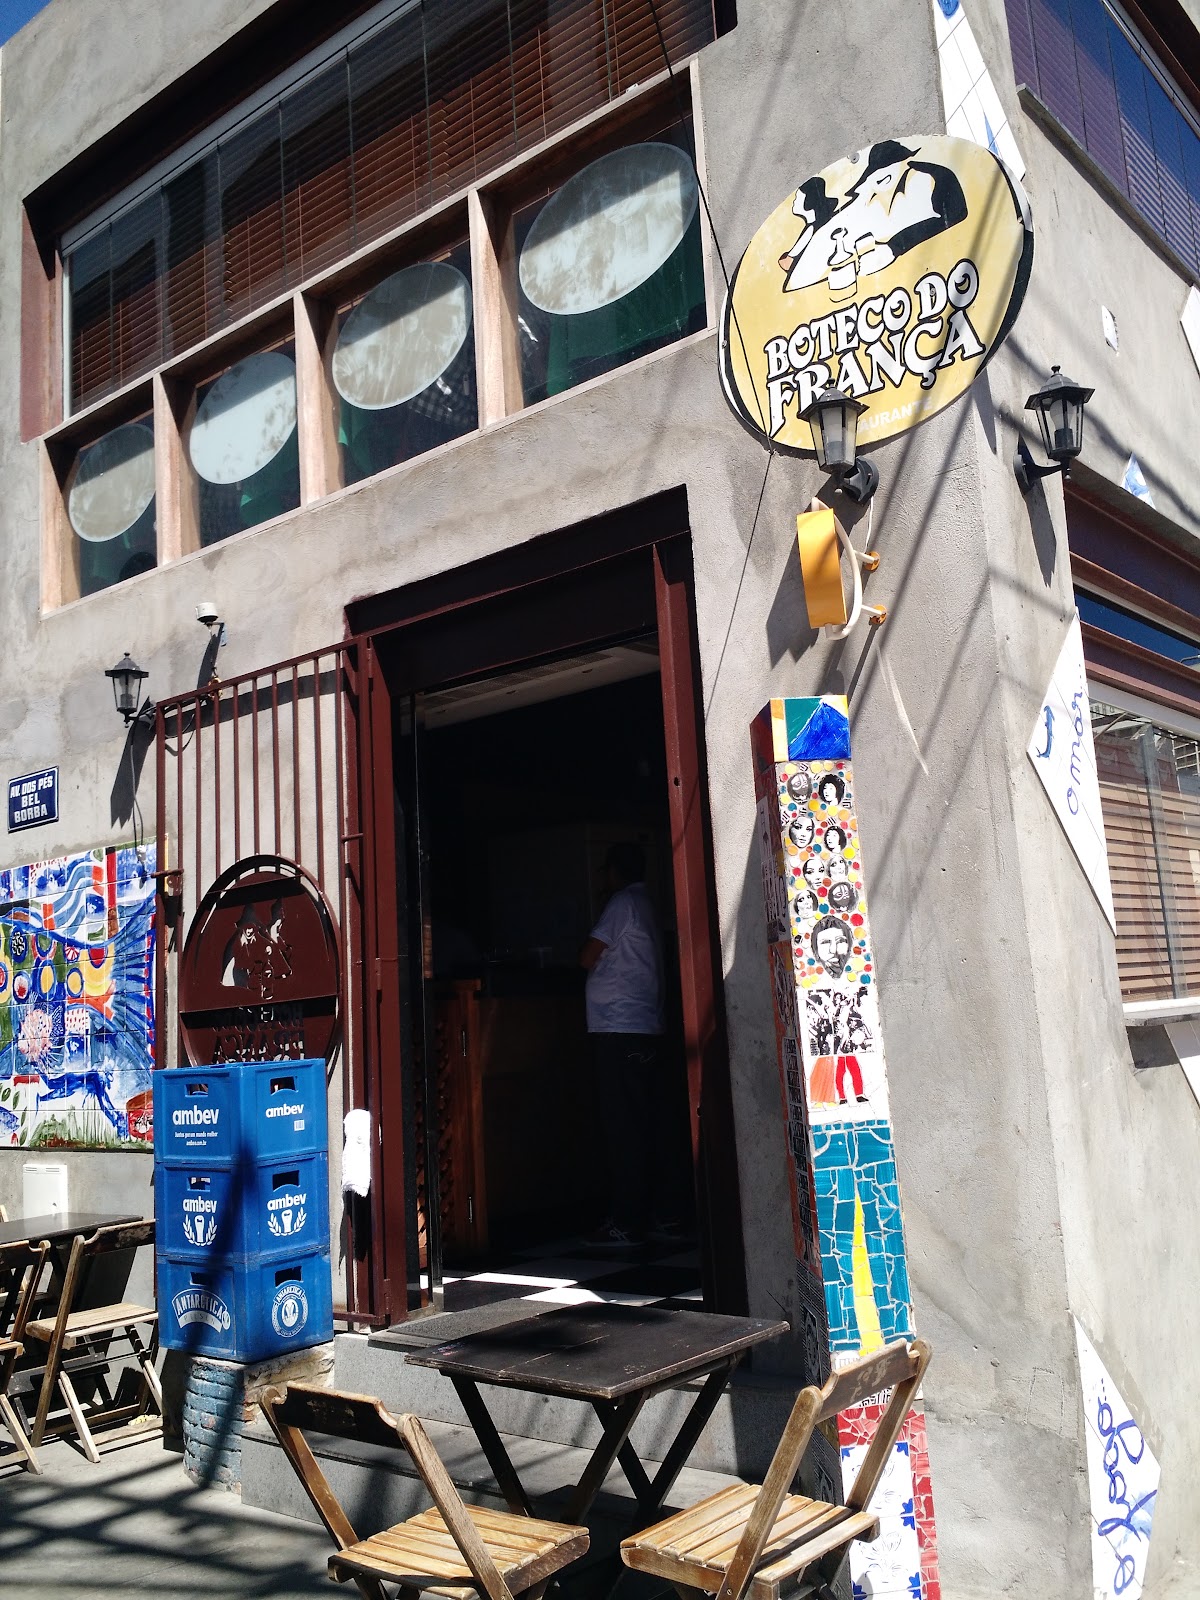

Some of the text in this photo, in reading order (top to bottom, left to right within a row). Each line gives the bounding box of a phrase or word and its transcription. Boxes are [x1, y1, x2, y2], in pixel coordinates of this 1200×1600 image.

[764, 258, 980, 380] BOTECO DO
[767, 308, 987, 439] FRANÇA
[858, 397, 935, 432] AURANTE
[10, 772, 53, 798] AV. DOS PÉS
[21, 792, 40, 808] BEL
[14, 803, 48, 823] BORBA
[172, 1104, 219, 1126] ambev
[265, 1103, 305, 1118] ambev
[182, 1195, 217, 1214] ambev
[267, 1193, 307, 1211] ambev
[175, 1293, 223, 1320] ANTARCTICA
